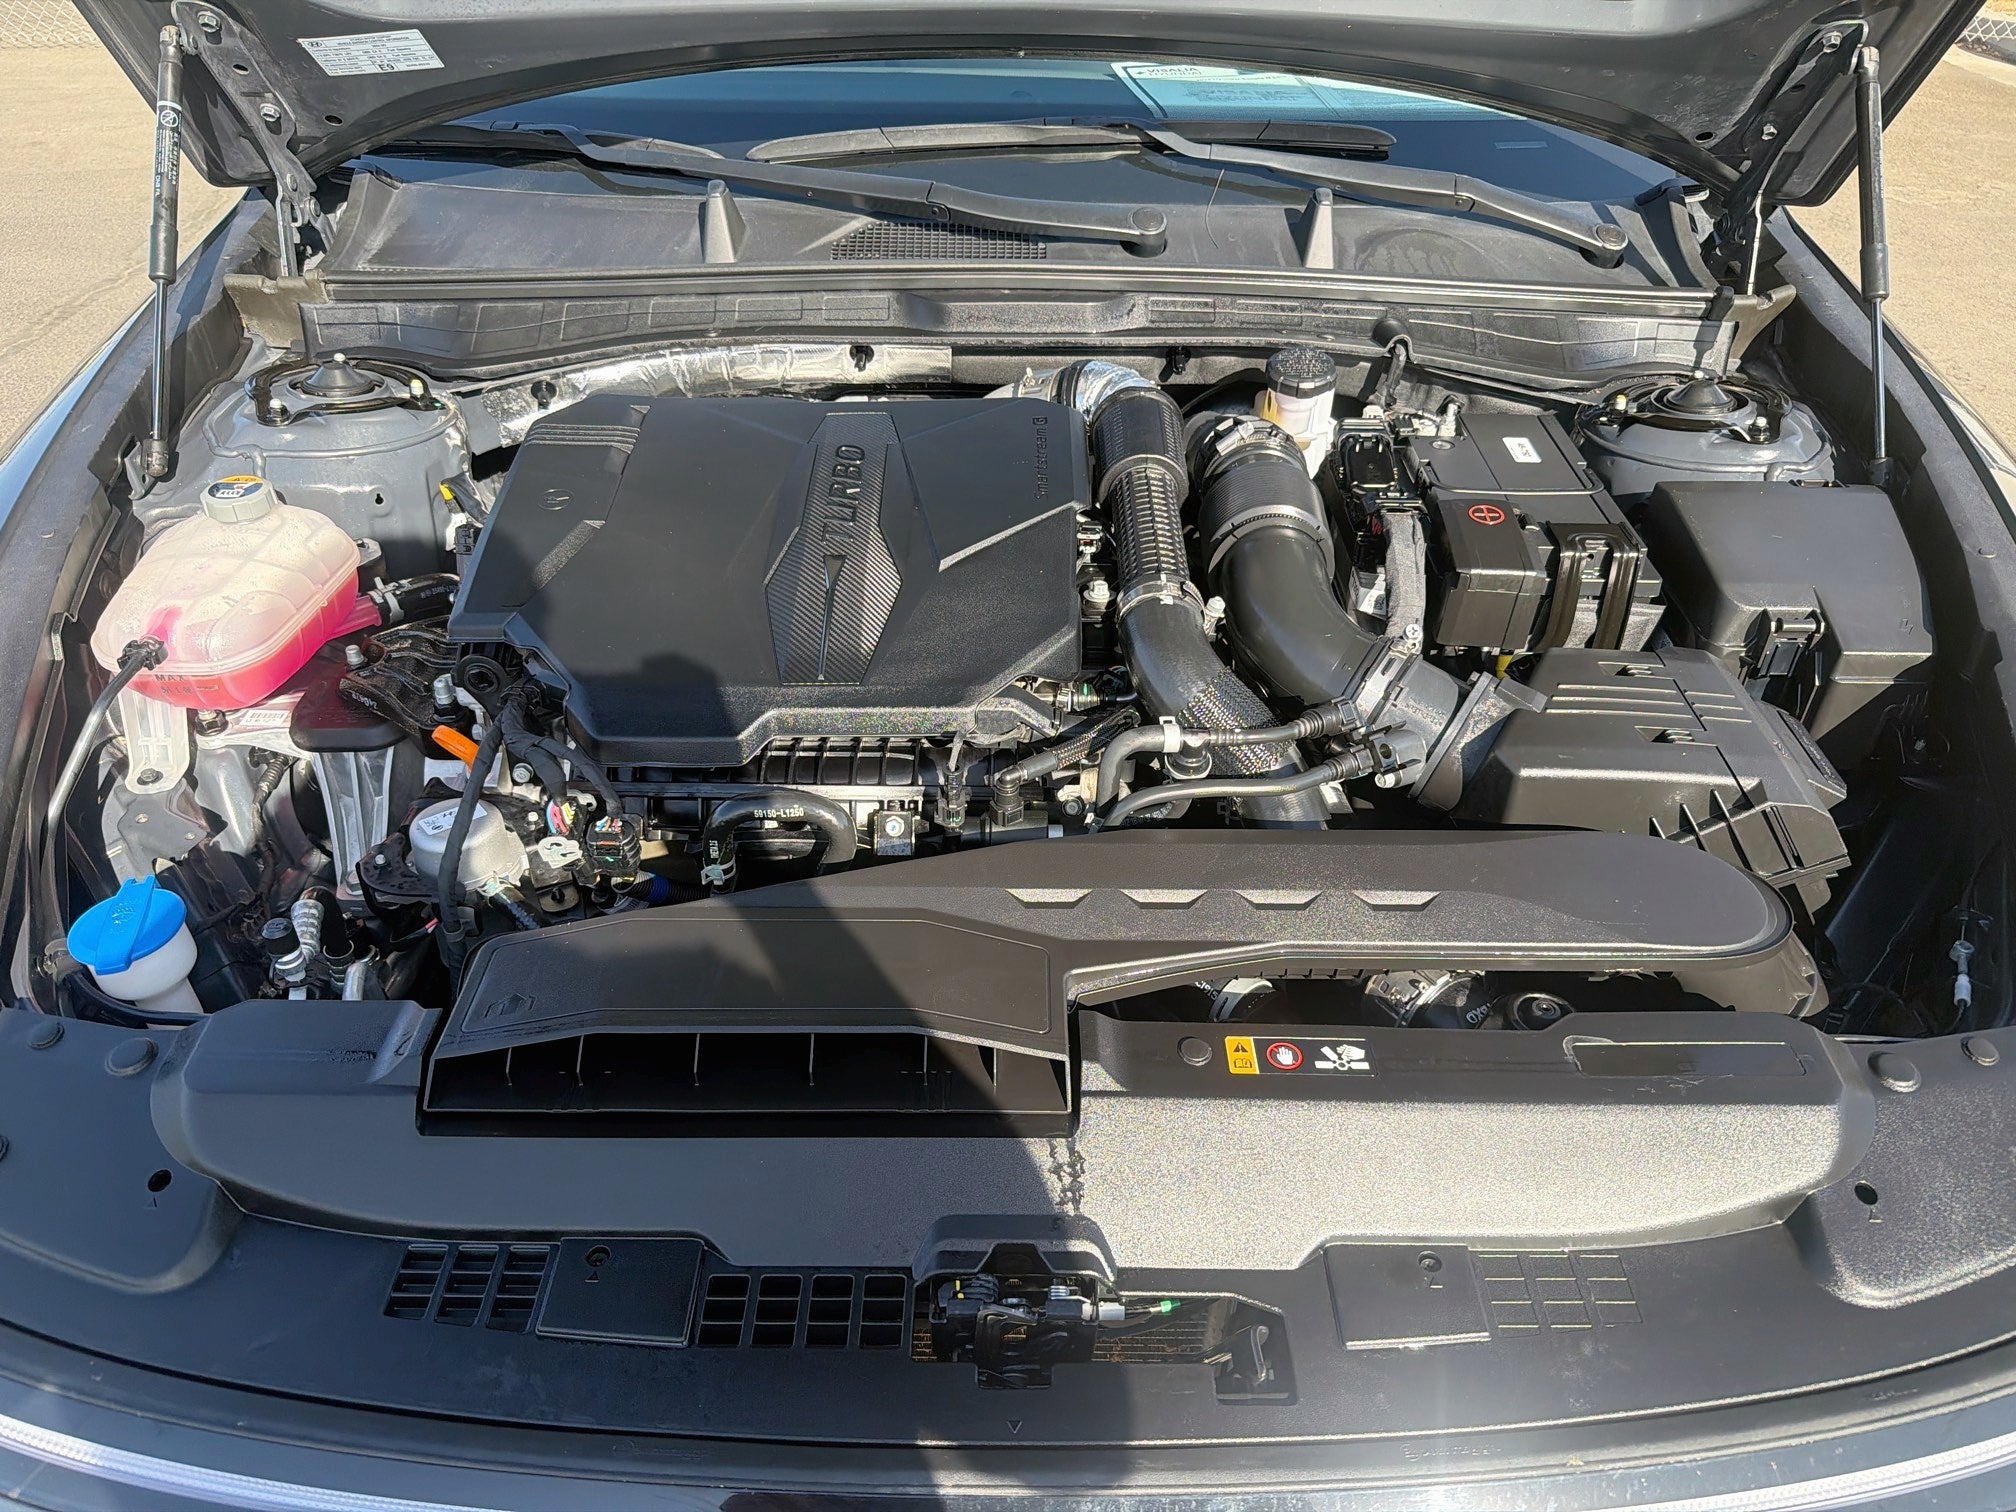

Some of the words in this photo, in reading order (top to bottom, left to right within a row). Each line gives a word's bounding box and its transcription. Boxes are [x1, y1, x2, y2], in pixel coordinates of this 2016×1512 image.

[1034, 426, 1048, 499] Smartstream
[822, 444, 866, 544] TURBO
[155, 674, 184, 682] MAX
[753, 807, 805, 818] 59150-L1250
